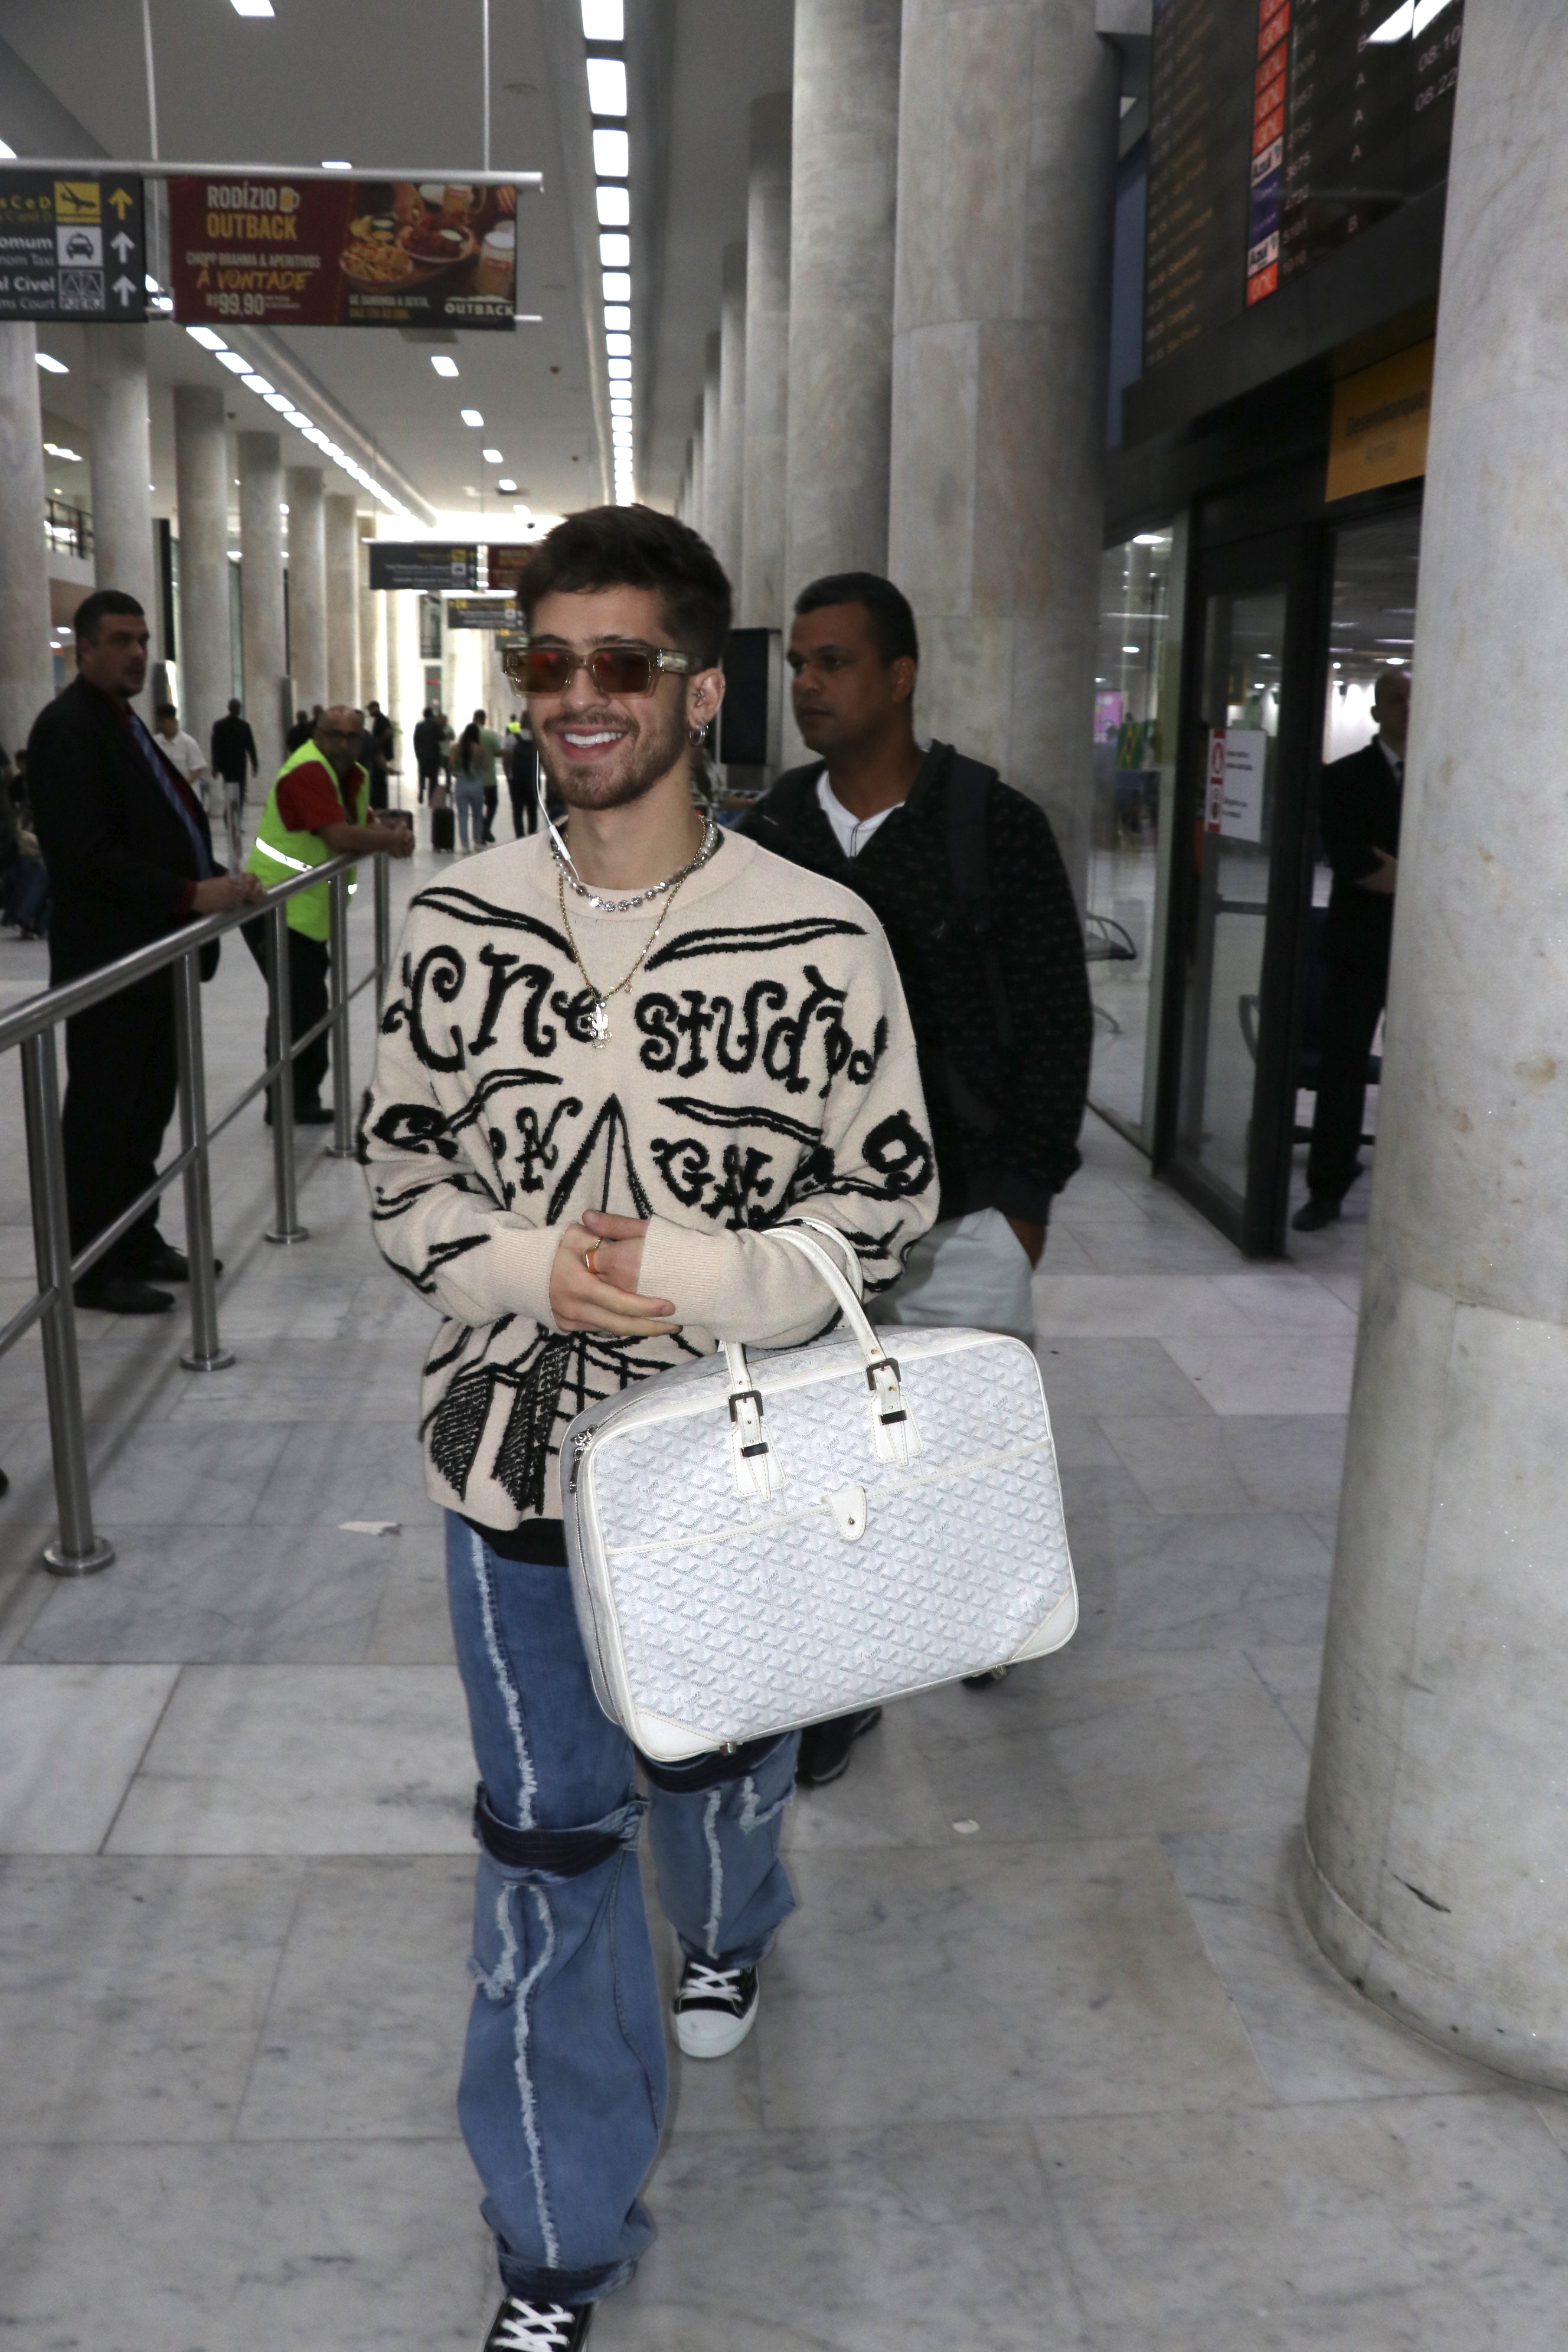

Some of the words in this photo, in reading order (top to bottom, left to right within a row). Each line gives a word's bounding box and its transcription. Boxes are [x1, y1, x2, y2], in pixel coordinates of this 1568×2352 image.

[207, 181, 277, 210] RODÍZIO
[207, 211, 298, 241] OUTBACK
[217, 269, 314, 291] VONTADE
[445, 302, 514, 316] OUTBACK
